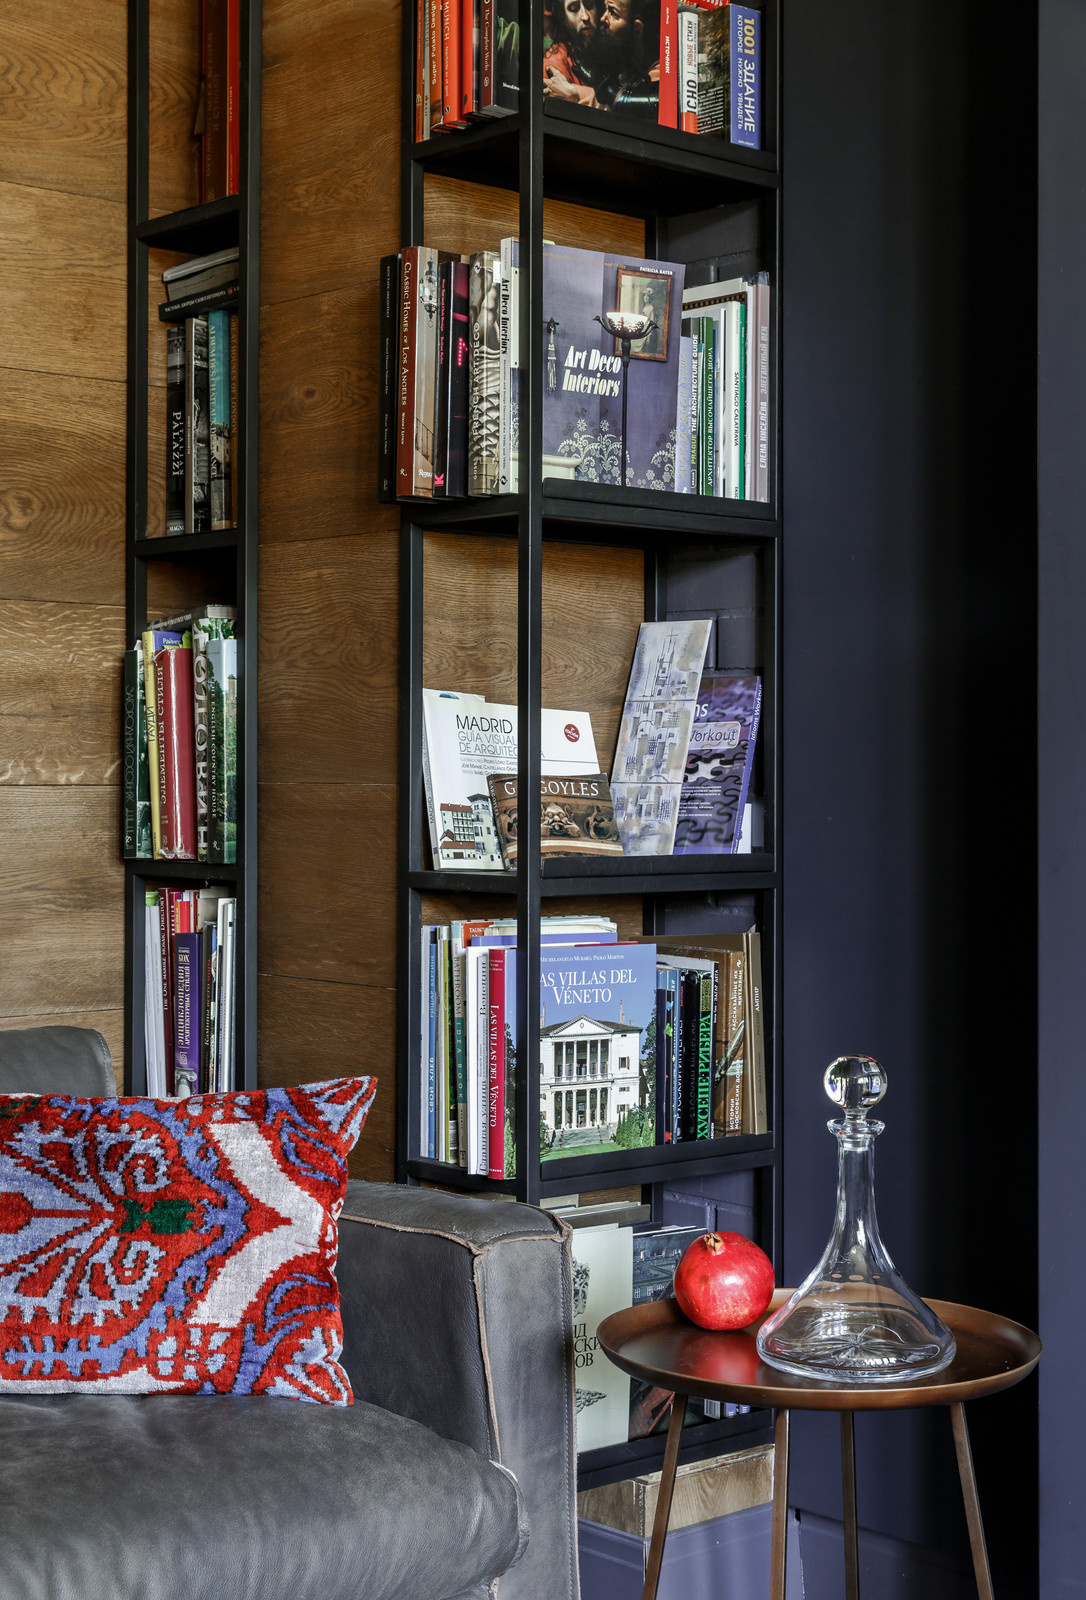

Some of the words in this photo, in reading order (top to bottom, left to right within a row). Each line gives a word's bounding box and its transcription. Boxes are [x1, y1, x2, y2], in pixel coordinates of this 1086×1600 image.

[743, 18, 756, 55] 1001
[743, 60, 756, 133] ЗДАНИЕ
[501, 278, 510, 292] Art
[640, 266, 659, 274] PATRICIA
[501, 293, 510, 315] Deco
[209, 325, 217, 359] ALBUM
[472, 322, 480, 357] DECO
[501, 317, 510, 355] Interiors
[209, 359, 217, 376] DES
[564, 346, 587, 369] Art
[588, 349, 622, 374] Deco
[680, 352, 688, 385] SMALL
[759, 343, 768, 394] ЭЛЕГАНТНЫЙ
[230, 383, 237, 395] OF
[562, 369, 621, 397] Interiors
[472, 387, 480, 435] FRENCH
[680, 391, 688, 425] HOUSE
[759, 402, 767, 442] КИСЕЛЁВА
[172, 410, 182, 476] PALAZZI
[679, 431, 688, 478] DESIGNS
[759, 443, 767, 468] ЕЛЕНА
[156, 666, 165, 716] СТИЛЯ
[754, 684, 762, 716] Workout
[146, 706, 155, 743] ГАУДИ
[456, 714, 513, 734] MADRID
[458, 730, 482, 743] GUÍA
[485, 734, 518, 746] VISUAL
[750, 716, 759, 741] Idioms
[158, 720, 167, 804] ЭЛЕМЕНТЫ
[459, 742, 472, 753] DE
[488, 780, 499, 816] GARGOYLES
[504, 780, 599, 797] GGOYLES
[453, 956, 462, 1015] BATHROOM
[479, 962, 487, 1016] Венеции
[540, 972, 556, 987] AS
[559, 970, 607, 986] VILLAS
[610, 969, 637, 984] DEL
[733, 970, 738, 979] ИХ
[553, 986, 612, 1006] VÉNETO
[490, 1005, 500, 1024] LAS
[490, 1028, 499, 1060] VILLAS
[698, 1015, 711, 1074] РИБЕРА
[490, 1063, 498, 1082] DEL
[490, 1085, 499, 1127] VÉNETO
[697, 1076, 711, 1139] ХУСЕПЕ
[479, 1123, 487, 1173] Главная
